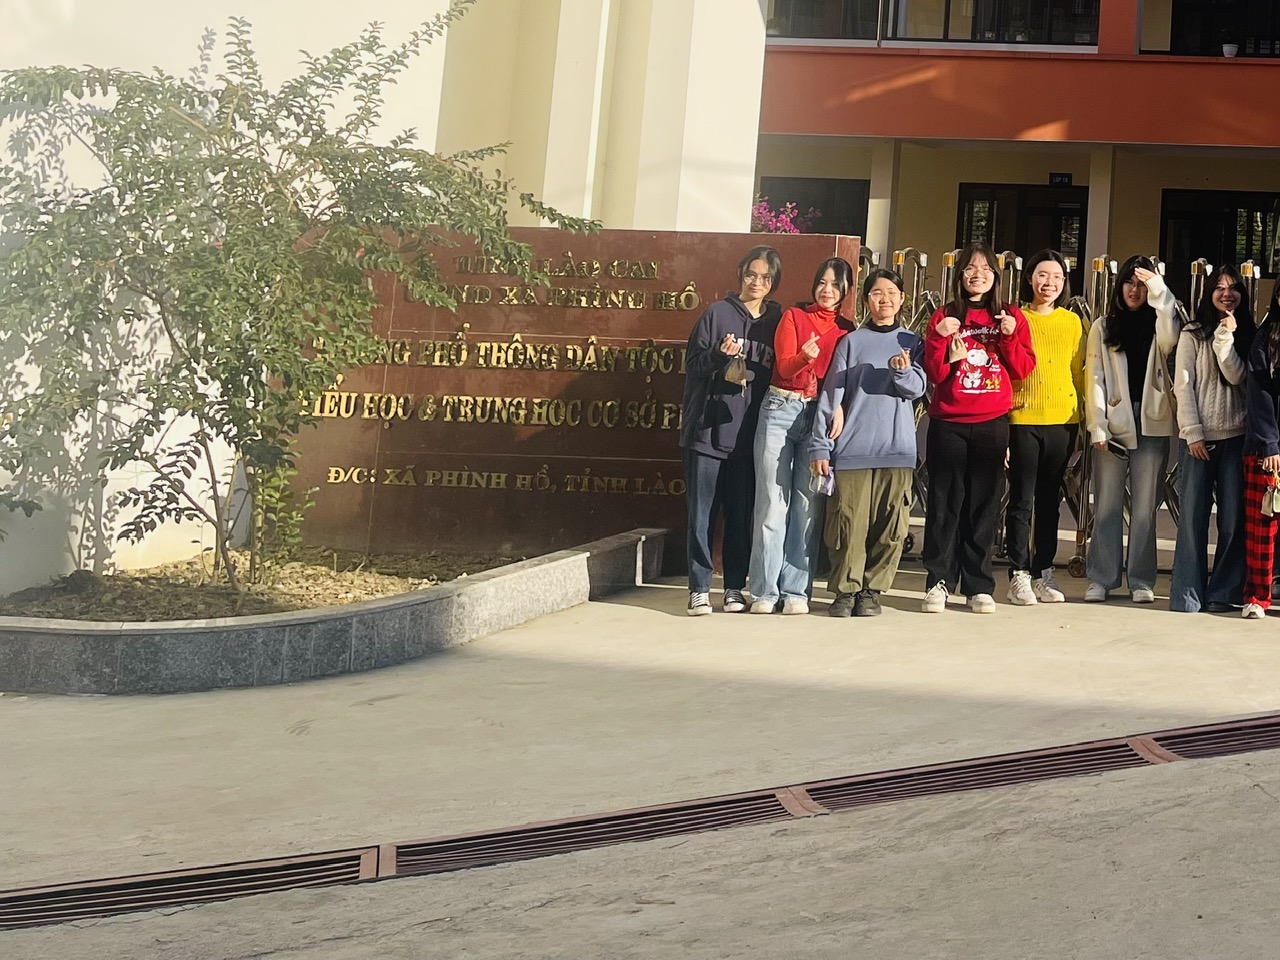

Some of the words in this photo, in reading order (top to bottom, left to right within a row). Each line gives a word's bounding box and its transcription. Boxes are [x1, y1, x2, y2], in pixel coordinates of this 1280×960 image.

[547, 282, 649, 309] PHÌNH
[416, 322, 468, 367] PHỔ
[475, 332, 560, 370] THÔNG
[565, 335, 621, 372] DÂN
[625, 338, 674, 384] TỘC
[360, 392, 415, 430] HỌC
[418, 394, 437, 422] &
[442, 394, 528, 426] TRUNG
[327, 465, 377, 484] Đ/C:
[382, 464, 418, 486] XÃ
[424, 464, 508, 489] PHÌNH
[564, 467, 629, 494] TỈNH
[632, 471, 688, 496] LÀO
